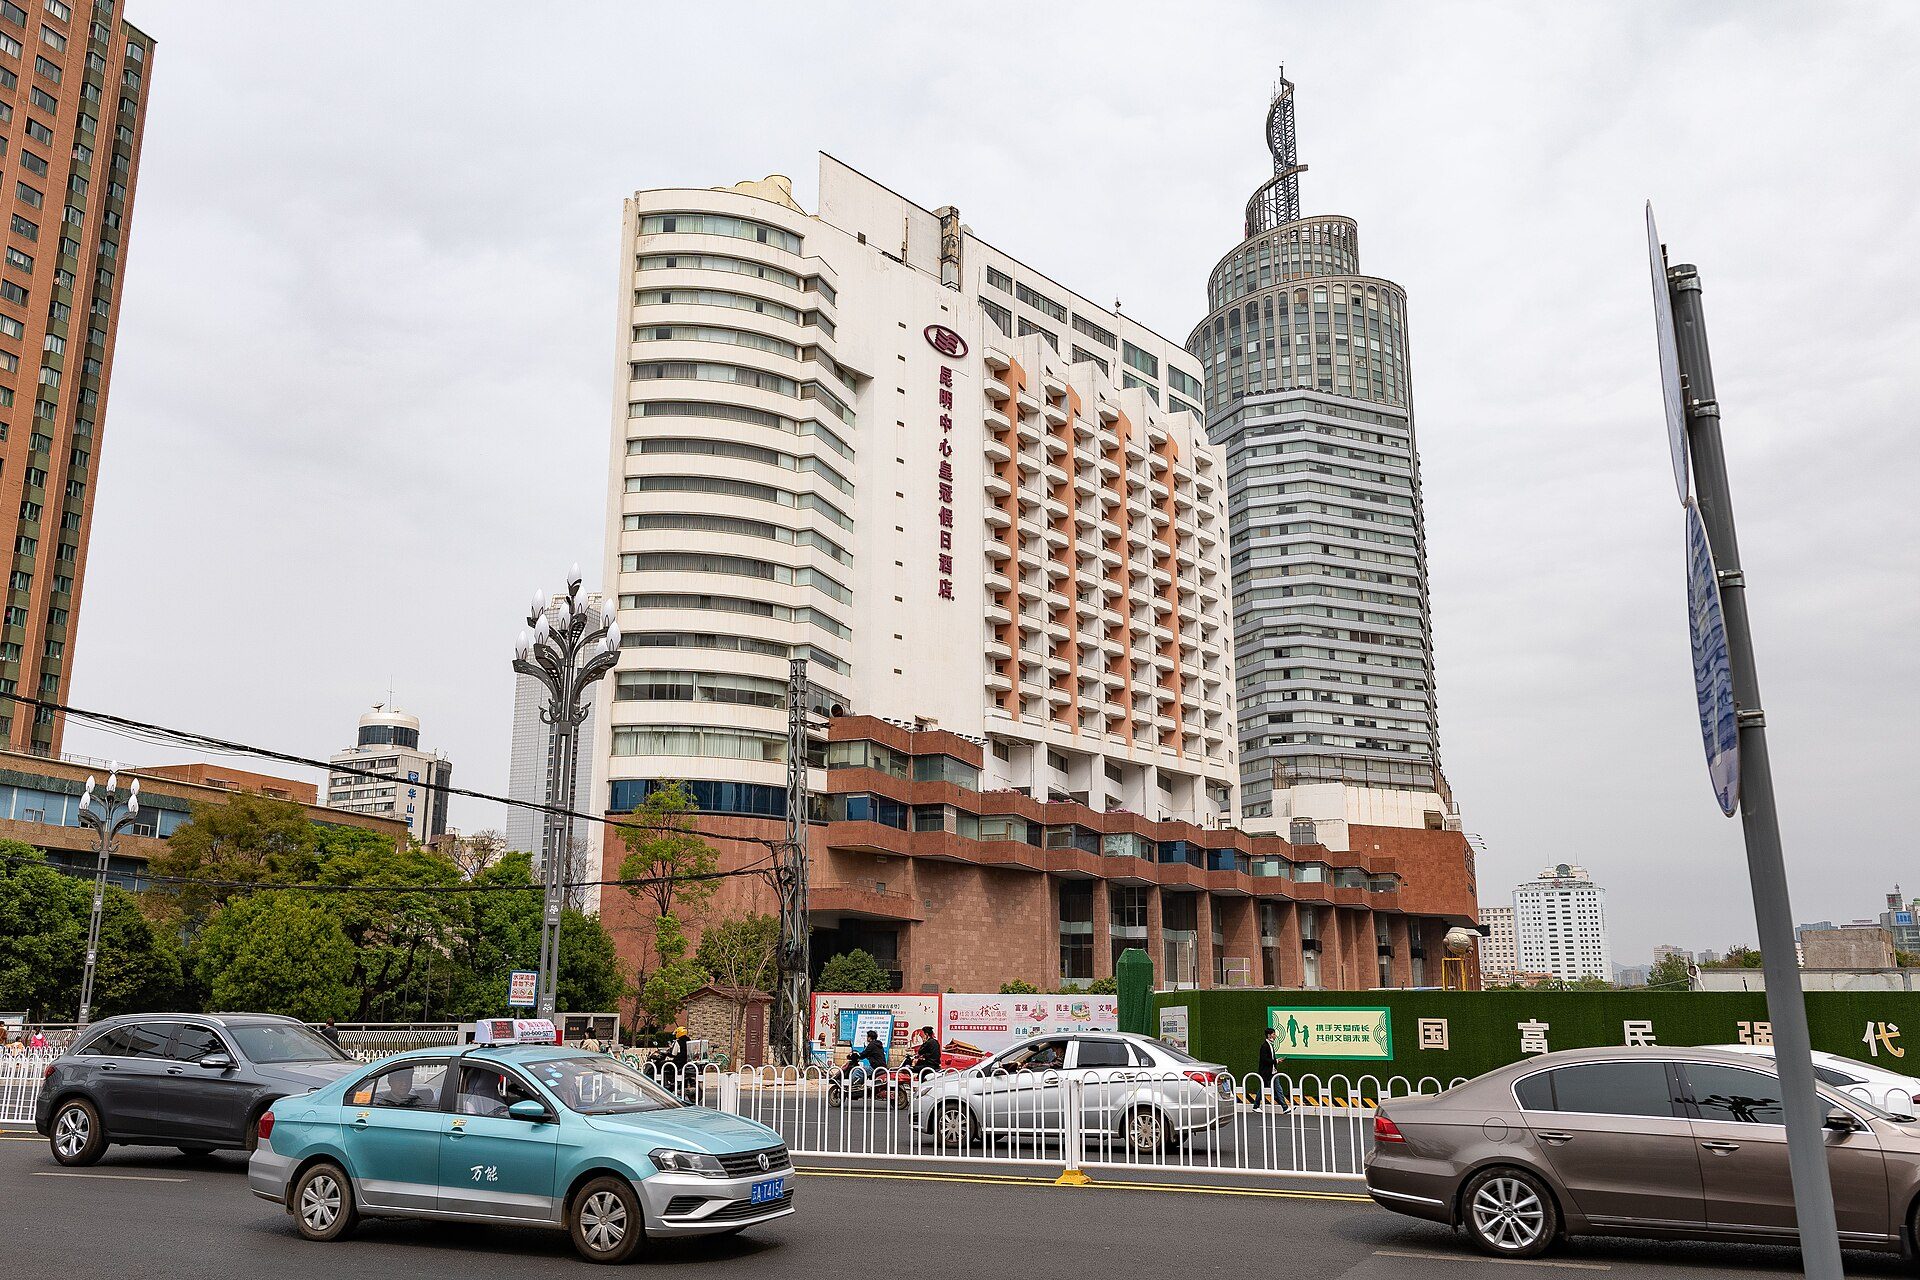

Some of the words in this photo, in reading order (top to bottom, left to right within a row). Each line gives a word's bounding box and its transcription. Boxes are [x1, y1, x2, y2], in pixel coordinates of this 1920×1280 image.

[939, 365, 953, 600] 昆明中心皇冠假日酒店
[1015, 1004, 1028, 1012] 富强
[1056, 1004, 1070, 1012] 民主
[1098, 1004, 1112, 1012] 文明
[1015, 1027, 1028, 1035] 自由
[1316, 1034, 1370, 1043] 共创文明未来
[1862, 1021, 1905, 1058] 代
[470, 1165, 499, 1182] 万能
